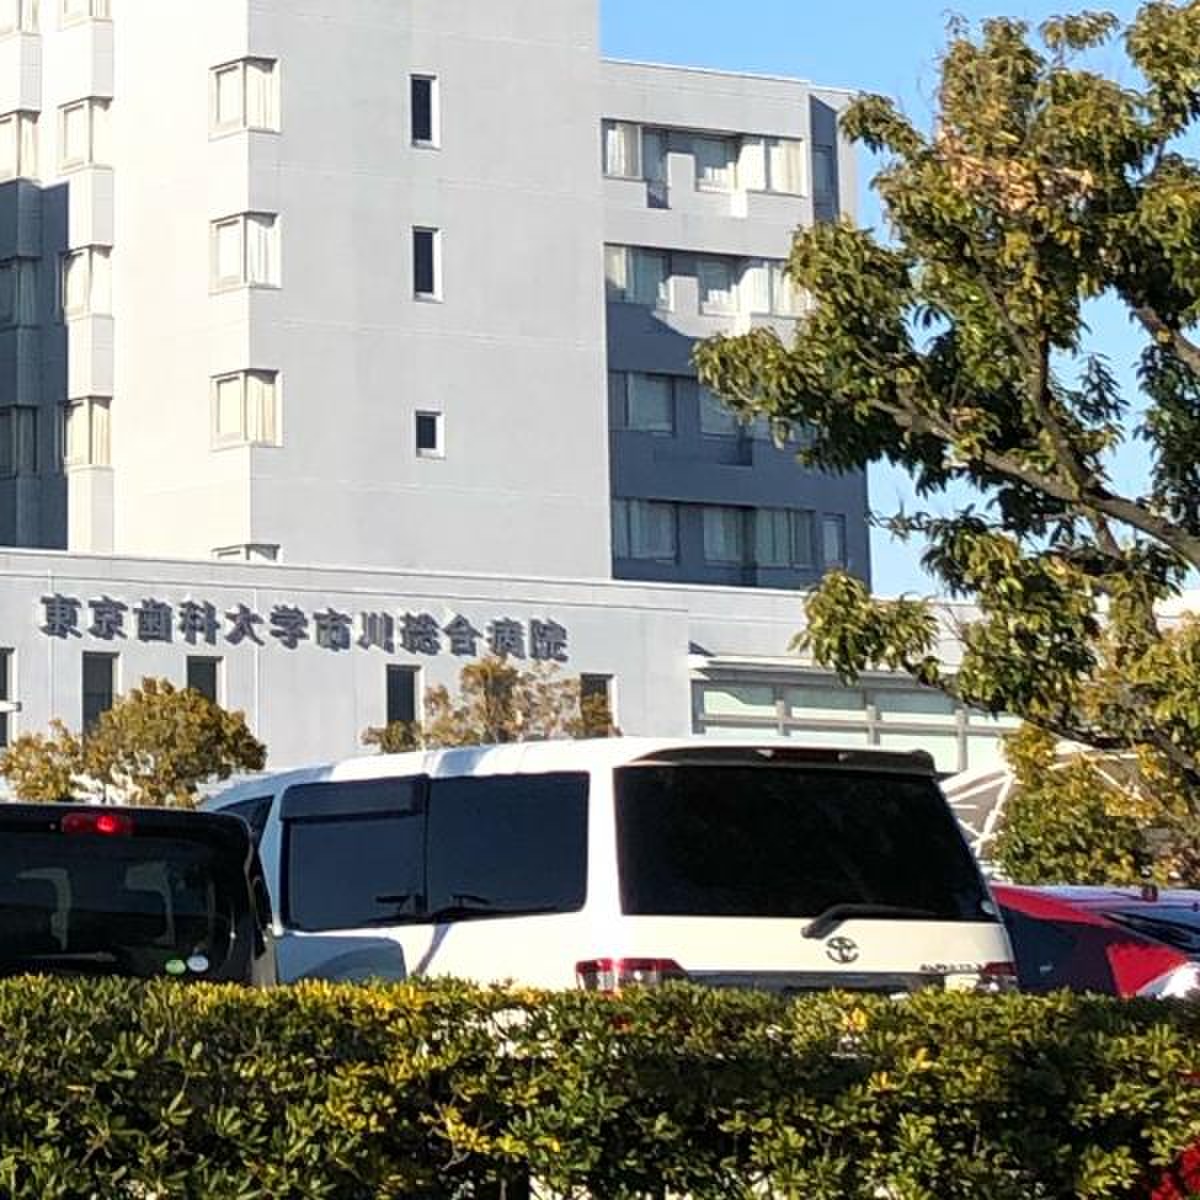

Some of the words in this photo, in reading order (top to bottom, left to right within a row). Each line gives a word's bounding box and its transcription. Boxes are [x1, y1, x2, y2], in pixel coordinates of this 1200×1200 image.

[39, 593, 569, 662] 東京歯科大学市川総合病院
